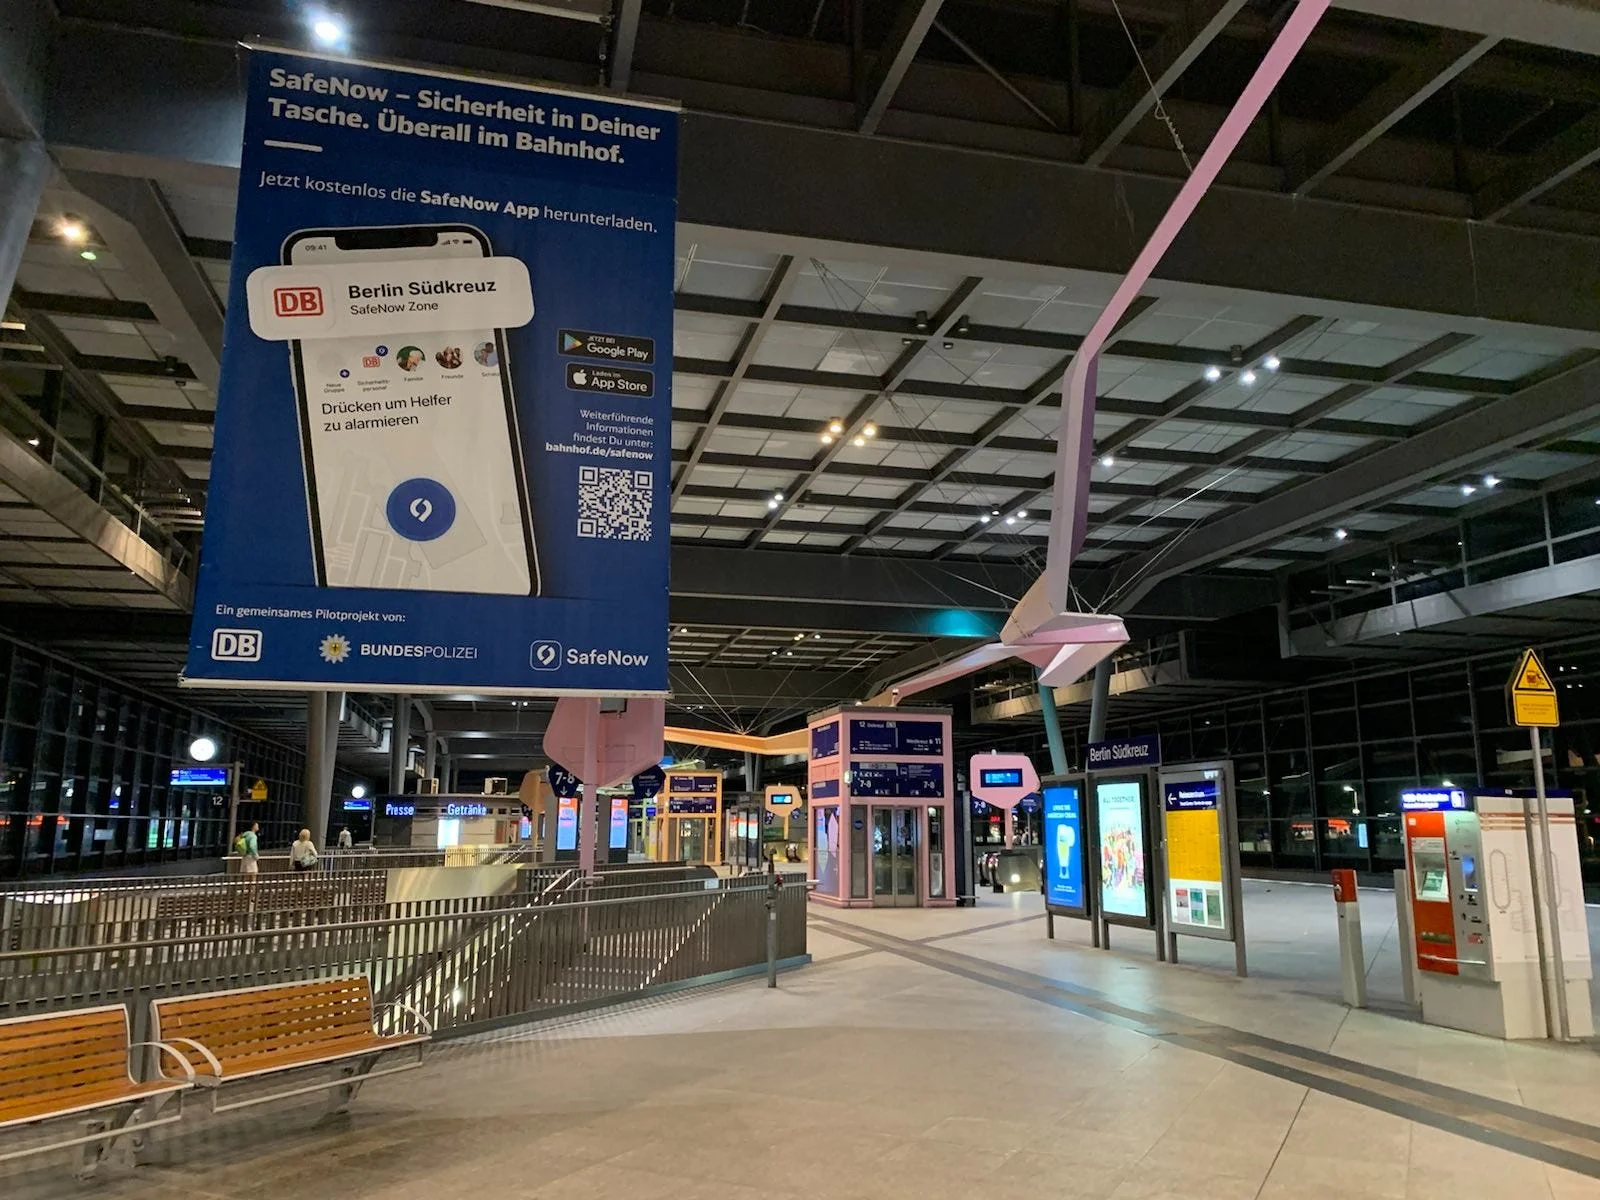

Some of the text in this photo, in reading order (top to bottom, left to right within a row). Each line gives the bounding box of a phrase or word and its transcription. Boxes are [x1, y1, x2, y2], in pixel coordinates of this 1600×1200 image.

[269, 68, 388, 102] SafeNow
[417, 90, 546, 126] Sicherheit
[551, 108, 574, 129] in
[581, 112, 660, 142] Deiner
[268, 98, 625, 165] Tasche. Überall im Bahnhof.
[259, 171, 659, 234] Jetzt kostenlos die SafeNow App herunterladen.
[348, 279, 497, 299] Berlin Südkreuz
[350, 301, 439, 315] SafeNow Zone
[587, 342, 649, 361] Google Play
[591, 377, 648, 392] App Store
[322, 394, 453, 415] Drücken um Helfer
[324, 415, 419, 432] zu alarmieren
[580, 409, 654, 425] Weiterführende
[586, 422, 654, 437] Informationen
[573, 432, 654, 449] findest Du unter:
[545, 442, 654, 461] bahnhof.de/safenow
[215, 605, 406, 624] Ein gemeinsames Pilotprojekt von:
[216, 632, 257, 658] DB
[360, 643, 478, 660] BUNDESPOLIZEI
[566, 647, 649, 667] SafeNow
[1090, 743, 1149, 762] Berlin Südkreuz
[555, 772, 576, 785] 7-8
[860, 780, 872, 788] 7-8
[923, 781, 935, 789] 7-8
[212, 796, 223, 806] 12
[385, 803, 415, 816] Presse
[447, 803, 487, 816] Getränke
